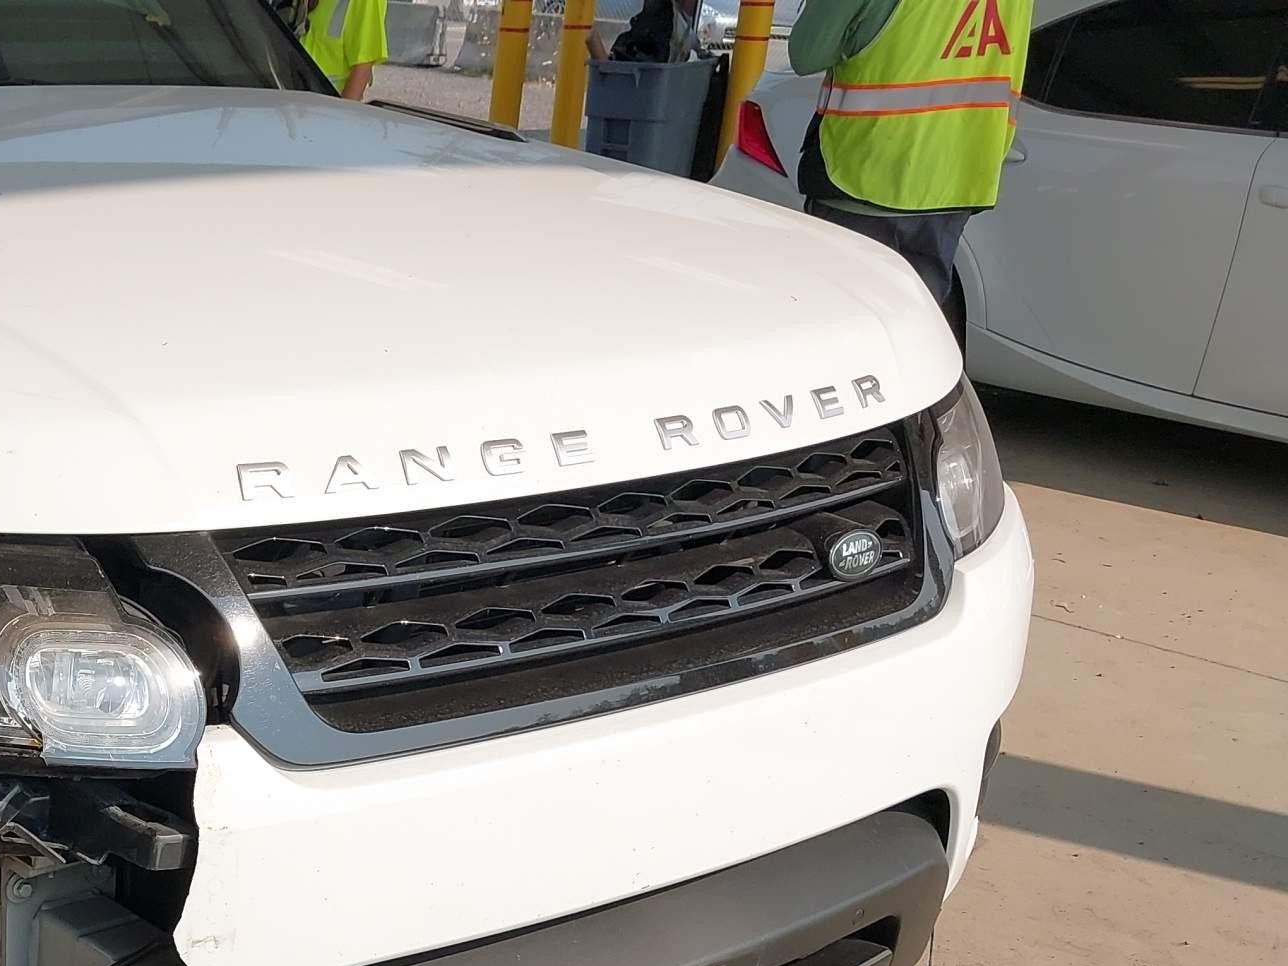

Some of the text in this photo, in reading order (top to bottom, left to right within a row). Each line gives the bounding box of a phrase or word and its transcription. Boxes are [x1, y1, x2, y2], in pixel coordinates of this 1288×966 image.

[236, 374, 886, 501] RANGE ROVER
[842, 539, 869, 557] LAND
[844, 550, 875, 570] ROVER
